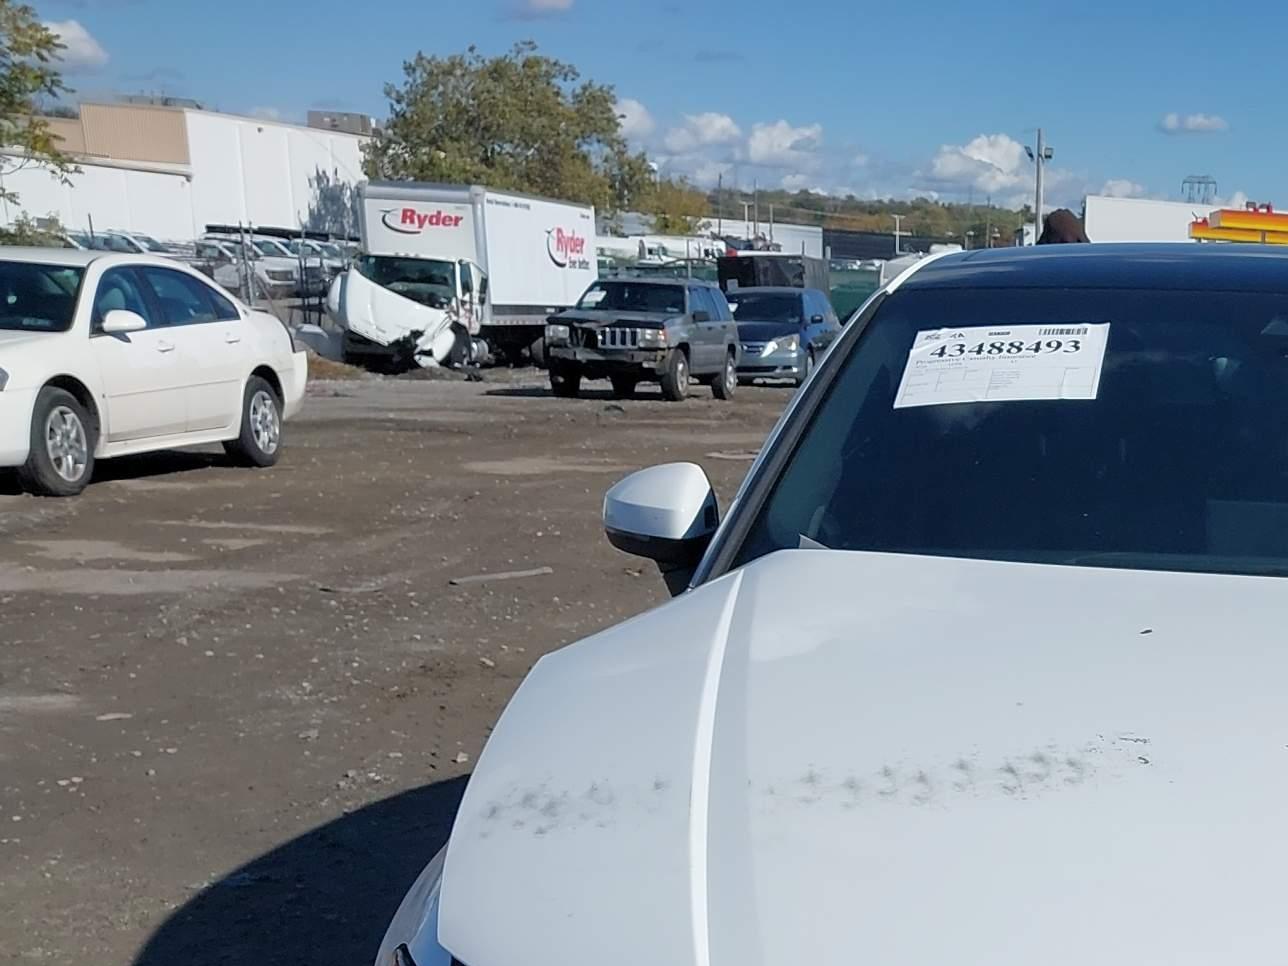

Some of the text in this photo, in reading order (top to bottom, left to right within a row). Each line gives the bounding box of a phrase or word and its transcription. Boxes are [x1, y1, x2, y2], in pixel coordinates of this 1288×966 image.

[401, 208, 463, 229] Ryder
[556, 227, 585, 259] Ryder
[930, 340, 1081, 358] 43488493
